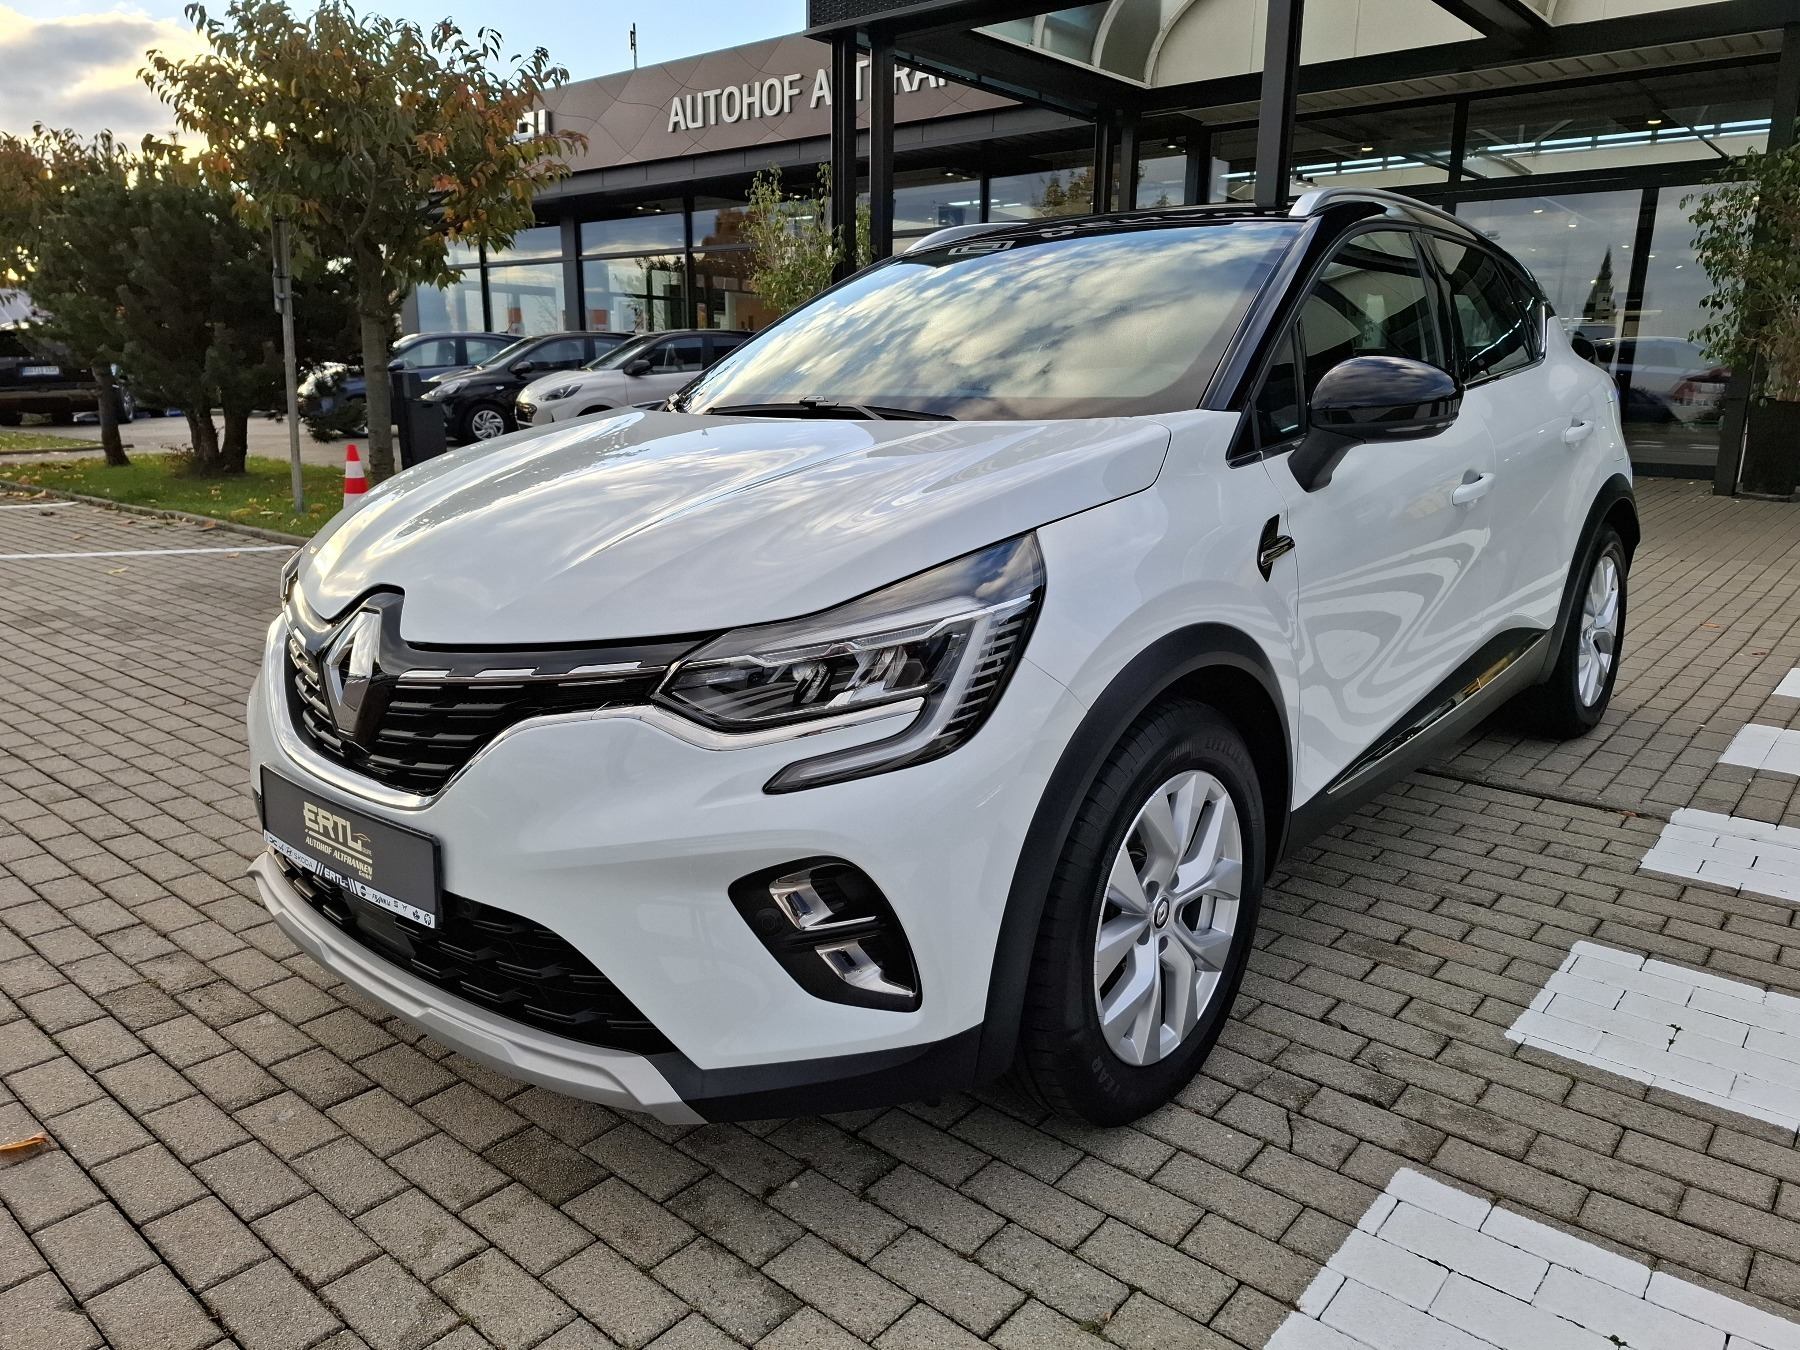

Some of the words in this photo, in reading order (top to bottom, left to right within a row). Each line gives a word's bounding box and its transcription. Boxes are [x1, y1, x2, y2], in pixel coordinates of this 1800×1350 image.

[667, 73, 802, 133] AUTOHOF
[303, 801, 363, 852] ERTL
[305, 836, 333, 855] AUTOHOF
[333, 849, 373, 876] ALTFRANKEN
